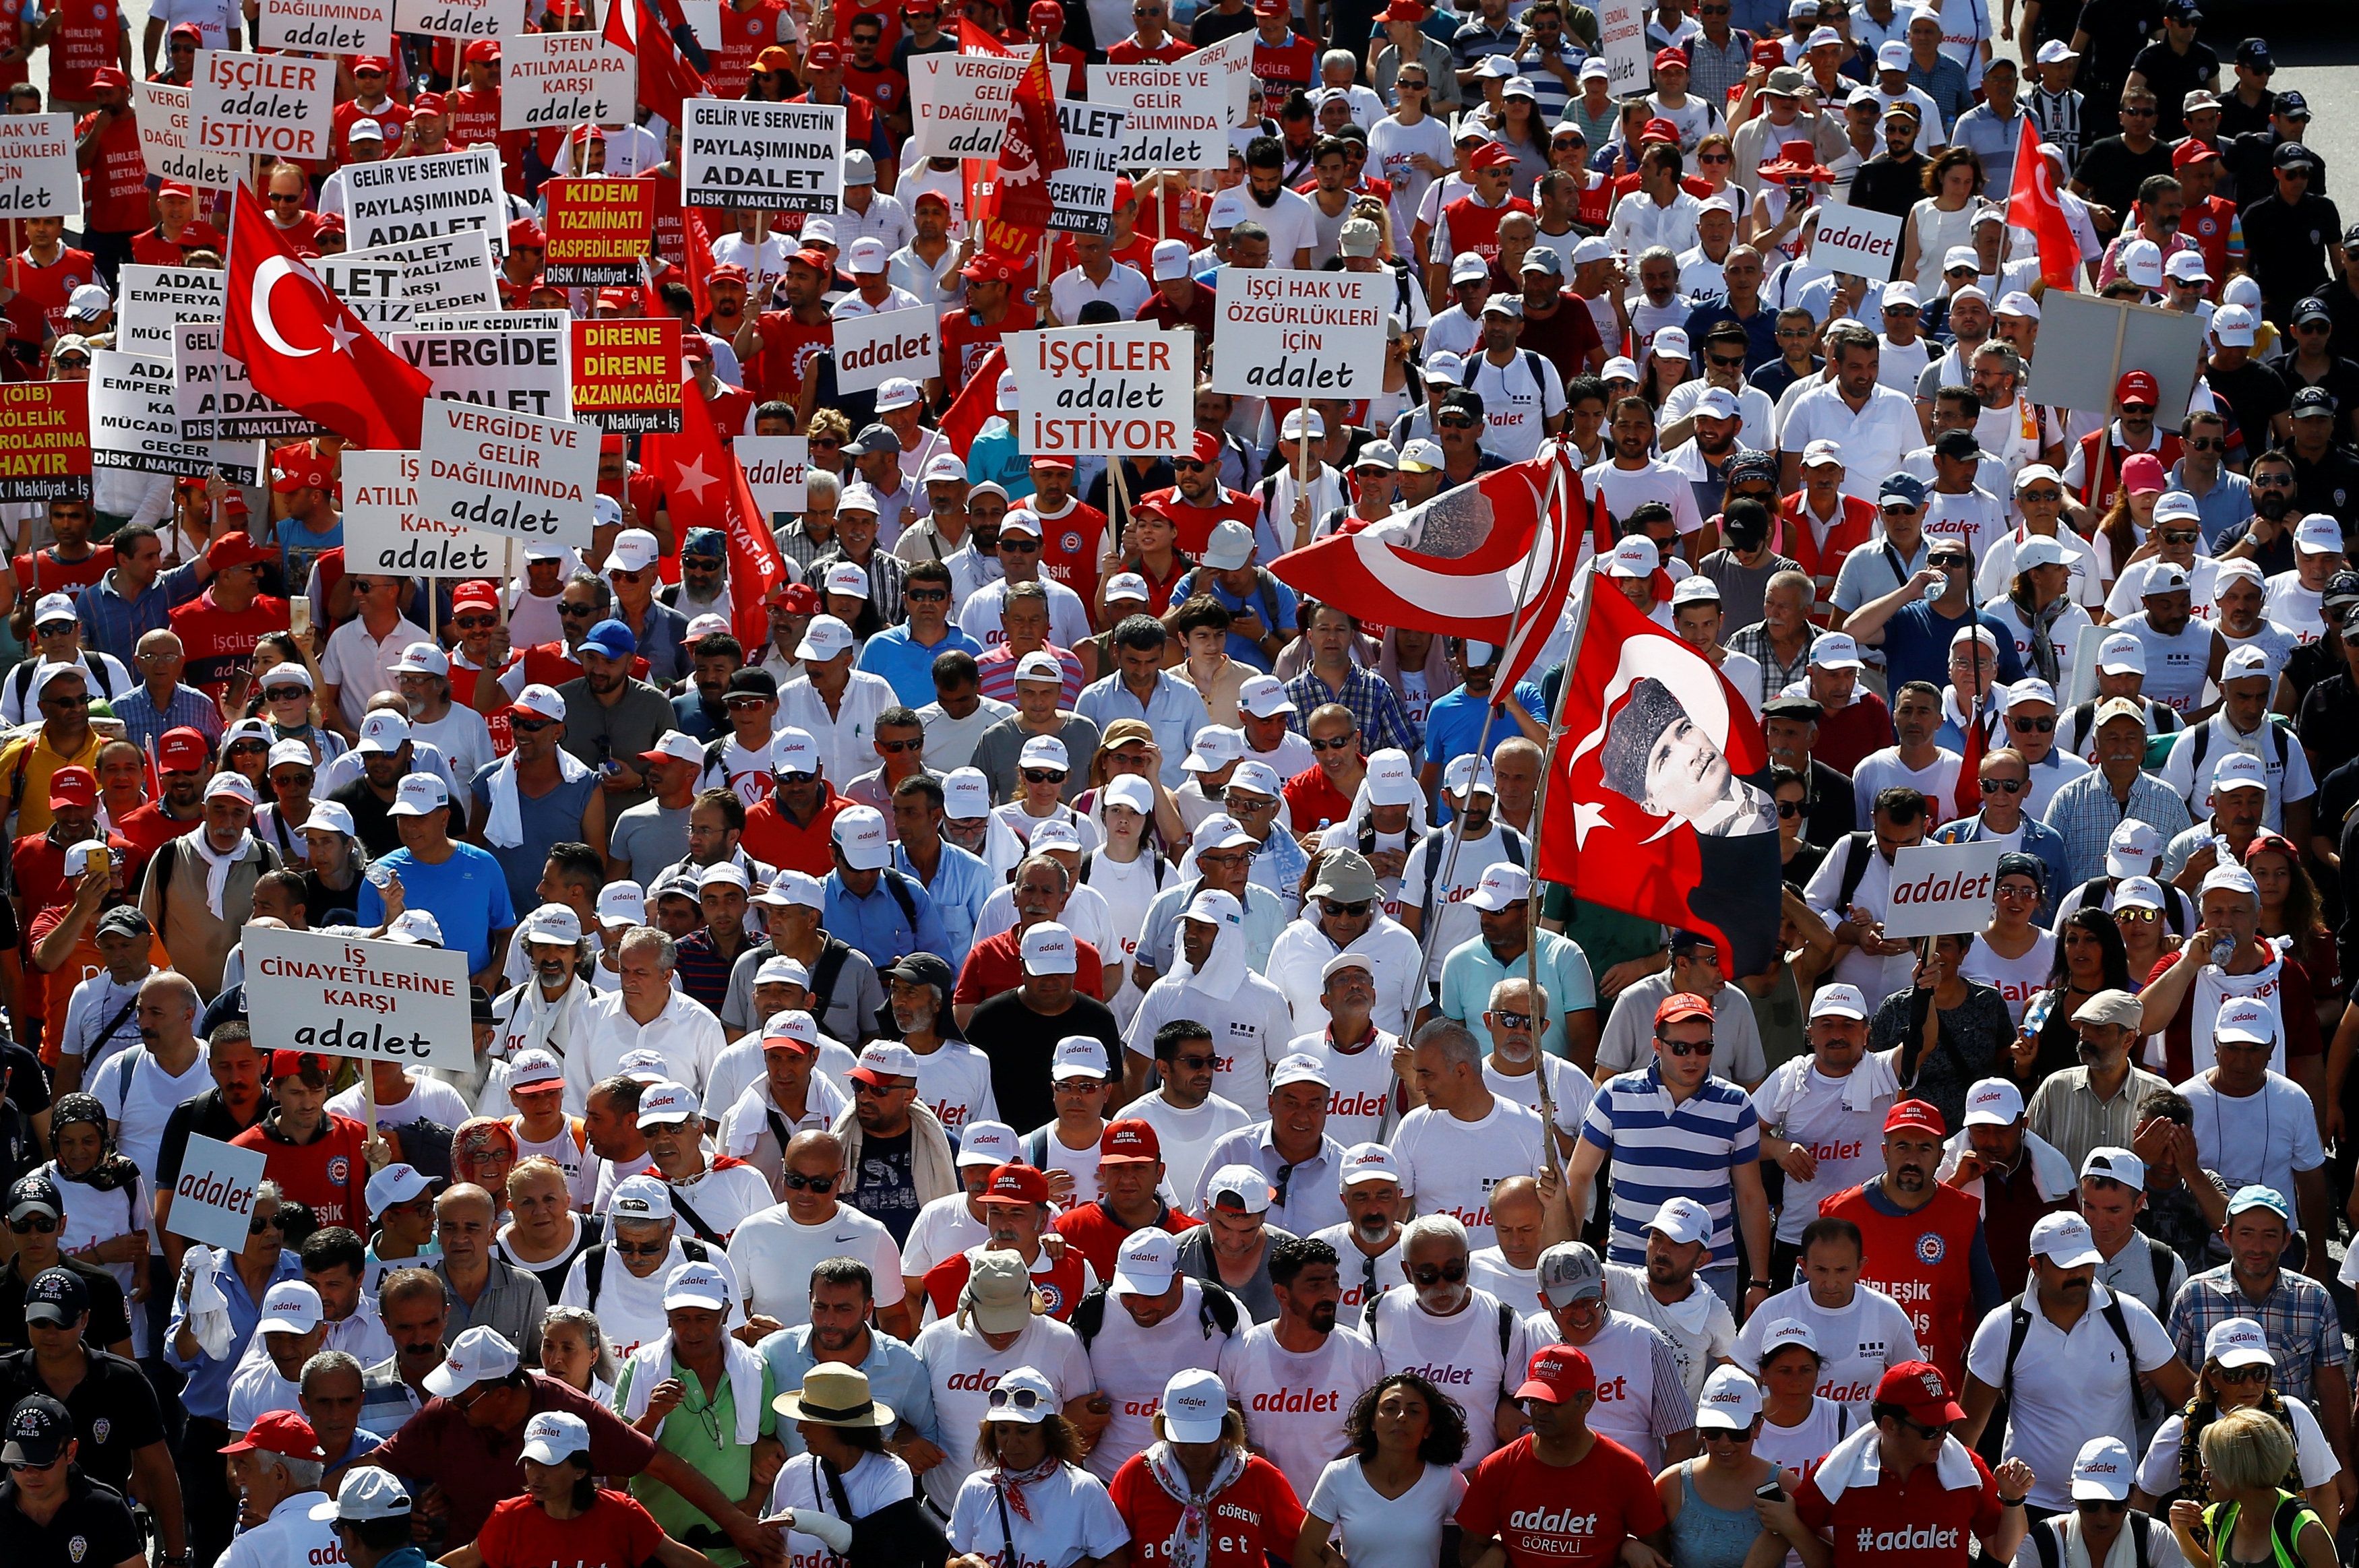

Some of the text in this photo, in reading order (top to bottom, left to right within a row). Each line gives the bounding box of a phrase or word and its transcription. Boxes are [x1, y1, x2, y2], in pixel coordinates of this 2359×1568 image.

[269, 0, 383, 22] DAĞILIMINDA
[420, 9, 499, 34] adalet
[284, 22, 364, 48] adalet
[544, 37, 593, 55] İŞTEN
[1200, 44, 1229, 67] GREV
[210, 54, 316, 91] İŞÇİLER
[510, 57, 625, 77] ATILMALARA
[956, 62, 1026, 81] VERGİDE
[543, 77, 593, 96] KARŞI
[1107, 70, 1208, 87] VERGİDE VE
[221, 91, 307, 119] adalet
[1134, 90, 1182, 108] GELİR
[526, 96, 608, 123] adalet
[695, 104, 834, 131] GELİR VE SERVETİN
[1125, 108, 1219, 130] ĞILIMINDA
[29, 123, 49, 136] VE
[200, 116, 315, 154] İSTİYOR
[693, 137, 834, 160] PAYLAŞIMINDA
[1120, 136, 1202, 162] adalet
[162, 155, 228, 184] adalet
[1093, 148, 1117, 172] İLE
[353, 154, 489, 187] GELİR VE SERVETİN
[702, 166, 824, 190] ADALET
[355, 188, 493, 218] PAYLAŞIMINDA
[565, 184, 639, 203] KIDEM
[691, 190, 834, 214] DİSK NAKLİYAT İŞ
[558, 207, 642, 230] TAZMİNATI
[1093, 214, 1108, 233] İŞ
[548, 237, 650, 259] GASPEDİLEMEZ
[1817, 226, 1894, 257] adalet
[547, 266, 625, 286] DİSK Nakliyat
[1246, 275, 1361, 300] İŞÇİ HAK VE
[1227, 303, 1379, 327] ÖZGÜRLÜKLERİ
[585, 324, 661, 346] DİRENE
[1282, 330, 1322, 354] İÇİN
[1667, 336, 1685, 344] adalet
[402, 333, 557, 367] VERGİDE
[841, 332, 931, 371] adalet
[1039, 334, 1171, 378] İŞÇİLER
[584, 353, 666, 377] DİRENE
[1246, 356, 1353, 389] adalet
[3, 385, 52, 406] (ÖİB)
[572, 379, 681, 405] KAZANACAĞIZ
[884, 390, 904, 400] adalet
[1056, 377, 1165, 408] adalet
[237, 420, 317, 435] NAKLİYAT
[448, 410, 577, 448] VERGİDE VE
[608, 412, 658, 433] Nakliyat
[1034, 412, 1177, 450] İSTİYOR
[142, 439, 209, 458] GEÇER
[479, 445, 540, 469] GELİR
[94, 451, 131, 468] DİSK
[15, 480, 63, 499] Nakliyat
[431, 459, 583, 503] DAĞILIMINDA
[451, 494, 559, 535] adalet
[379, 538, 488, 570] adalet
[837, 575, 859, 584] adalet
[1114, 580, 1137, 589] adalet
[1261, 686, 1279, 695] adalet
[784, 744, 804, 752] adalet
[1241, 770, 1263, 778] adalet
[858, 830, 879, 840] adalet
[1041, 829, 1064, 838] adalet
[2119, 846, 2143, 855] adalet
[1893, 870, 1991, 906] adalet
[2124, 885, 2147, 893] adalet
[543, 917, 567, 926] adalet
[344, 943, 366, 968] İŞ
[1039, 943, 1063, 951] adalet
[259, 955, 456, 997] CİNAYETLERİNE
[324, 989, 397, 1015] KARŞI
[1824, 992, 1849, 1001] adalet
[2232, 1013, 2257, 1022] adalet
[294, 1018, 431, 1058] adalet
[1229, 1029, 1254, 1038] Beşiktaş
[522, 1061, 549, 1072] adalet
[628, 1060, 652, 1069] adalet
[865, 1052, 886, 1063] adalet
[647, 1096, 674, 1108] adalet
[1977, 1092, 2000, 1103] adalet
[974, 1135, 1000, 1143] adalet
[1356, 1154, 1384, 1164] adalet
[998, 1175, 1016, 1184] DİSK
[177, 1169, 253, 1216] adalet
[1664, 1207, 1690, 1219] adalet
[2060, 1226, 2084, 1236] adalet
[1130, 1253, 1159, 1261] adalet
[679, 1277, 707, 1285] adalet
[273, 1303, 301, 1311] adalet
[1776, 1327, 1806, 1337] adalet
[2230, 1333, 2258, 1343] adalet
[1534, 1358, 1564, 1372] adalet
[1535, 1369, 1556, 1378] GÖREVLİ
[1179, 1397, 1206, 1406] adalet
[1253, 1387, 1339, 1412] adalet
[1711, 1392, 1740, 1403] adalet
[16, 1429, 40, 1437] POLİS
[532, 1427, 560, 1439] adalet
[2084, 1462, 2116, 1473] adalet
[1218, 1503, 1260, 1528] GÖREVLİ
[1510, 1506, 1597, 1535] adalet
[1522, 1535, 1579, 1554] GÖREVLİ
[1857, 1523, 1959, 1553] #adalet
